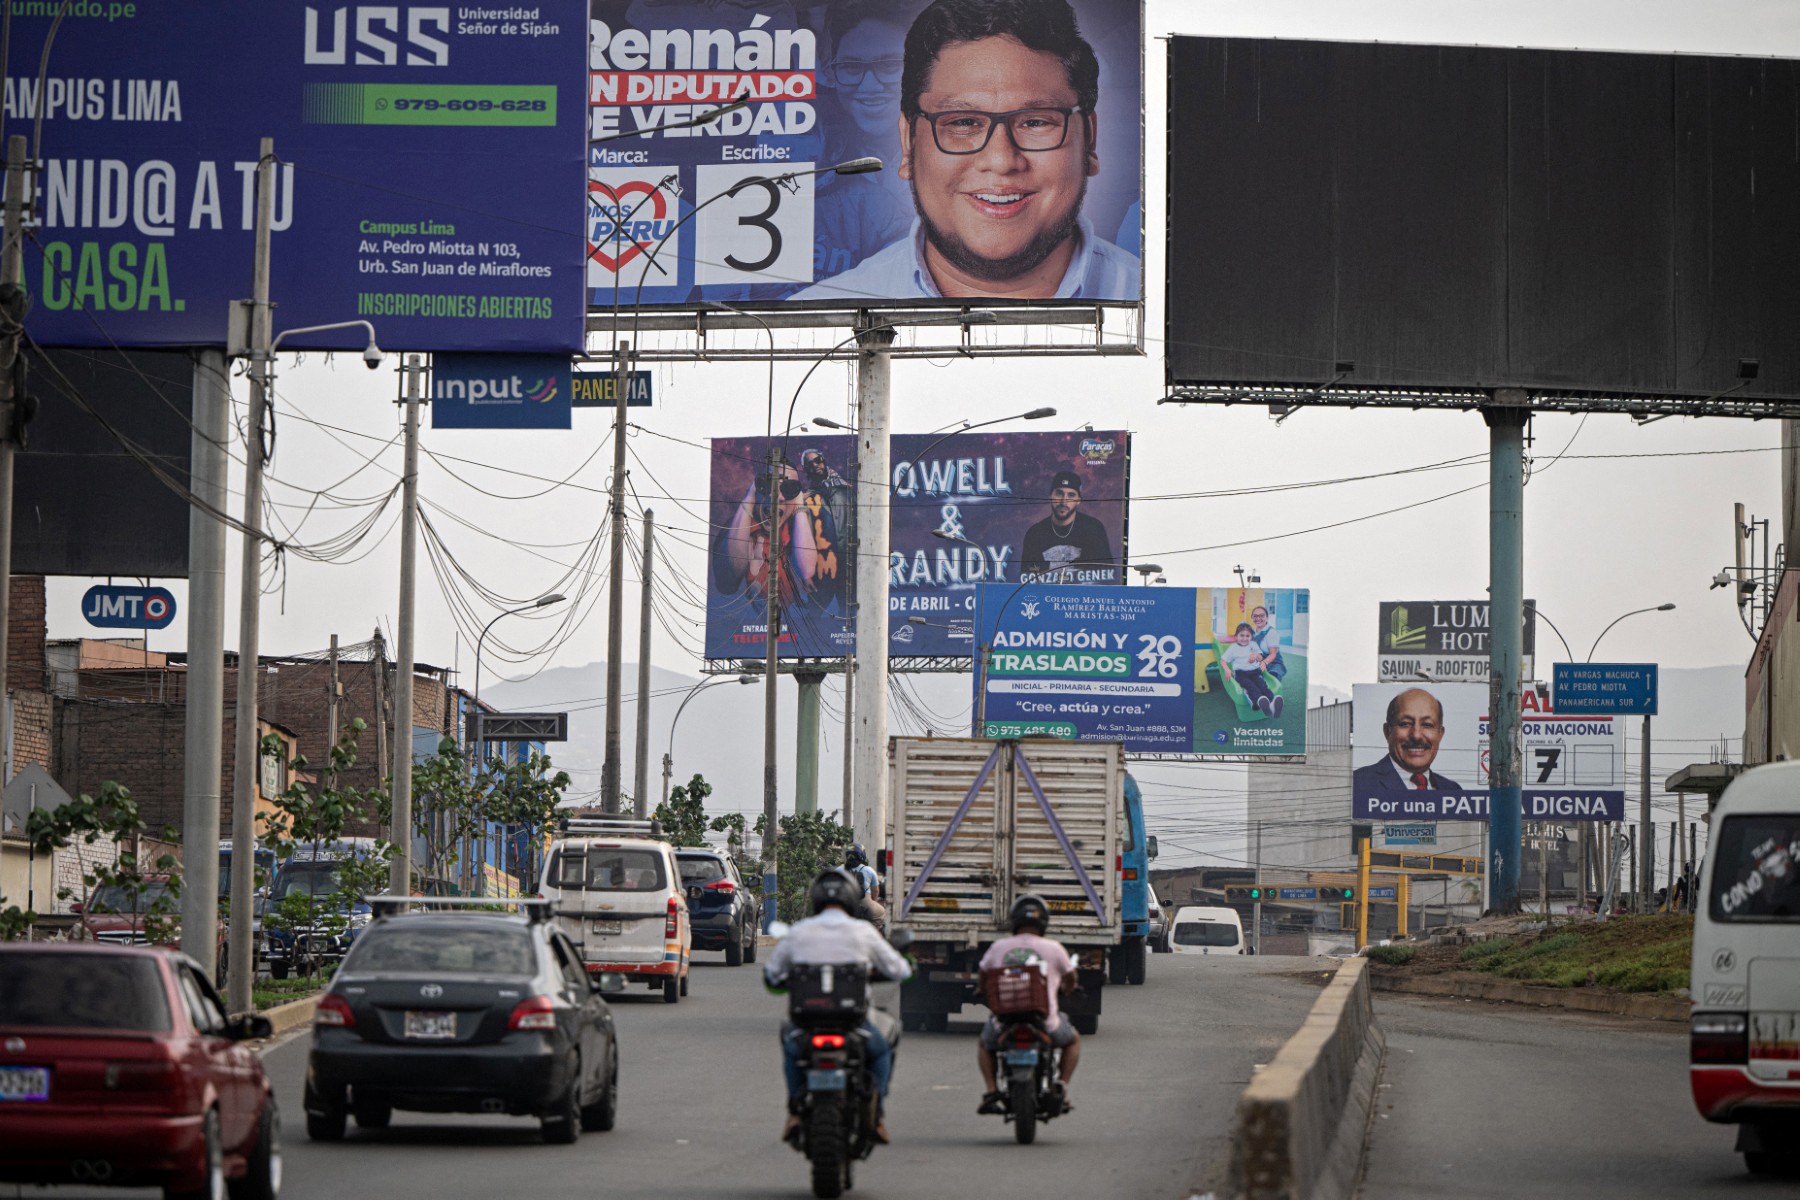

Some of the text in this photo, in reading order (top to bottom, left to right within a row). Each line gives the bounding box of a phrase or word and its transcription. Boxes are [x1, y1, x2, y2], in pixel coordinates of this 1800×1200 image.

[1, 0, 136, 22] umundo.pe
[459, 8, 540, 20] Universidad
[304, 6, 449, 66] USS
[458, 21, 559, 37] Señor de Sipán
[627, 74, 813, 102] DIPUTADO
[112, 79, 182, 122] LIMA
[394, 99, 546, 112] 979-609-628
[630, 102, 817, 139] VERDAD
[592, 144, 790, 164] Marca: Escribe:
[189, 161, 223, 230] A
[234, 162, 295, 232] TU
[360, 220, 455, 236] Campus Lima
[592, 220, 675, 242] PERU
[724, 176, 782, 272] 3
[358, 240, 521, 259] Av. Pedro Miotta N 103,
[42, 241, 186, 312] CASA.
[359, 260, 552, 277] Urb. San Juan de Miraflores
[358, 293, 552, 319] INSCRIPCIONES ABIERTAS
[437, 375, 523, 404] input
[1082, 440, 1112, 451] Paracas
[893, 457, 1011, 497] OWELL
[940, 504, 967, 541] &
[1020, 569, 1115, 584] GONZAO GENEK
[890, 597, 906, 611] DE
[911, 596, 950, 610] ABRIL
[1054, 602, 1146, 614] RAMÍREZ BARINAGA
[993, 629, 1106, 649] ADMISIÓN
[1113, 634, 1128, 649] Y
[1138, 634, 1182, 656] 20
[992, 654, 1127, 673] TRASLADOS
[1138, 654, 1178, 678] 26
[1382, 660, 1421, 676] SAUNA
[1099, 684, 1154, 693] SECUNDARIA
[1060, 702, 1098, 713] actúa
[1102, 706, 1110, 716] y
[1558, 698, 1634, 706] PANAMERICANA SUR
[1000, 726, 1020, 736] 975
[1048, 726, 1072, 736] 480
[1234, 728, 1284, 736] Vacantes
[1545, 724, 1614, 736] NACIONAL
[1234, 738, 1284, 746] limitadas
[1535, 748, 1561, 782] 7
[1368, 798, 1398, 812] Por
[1404, 801, 1436, 812] una
[1532, 796, 1608, 816] DIGNA
[1386, 827, 1434, 837] Universal
